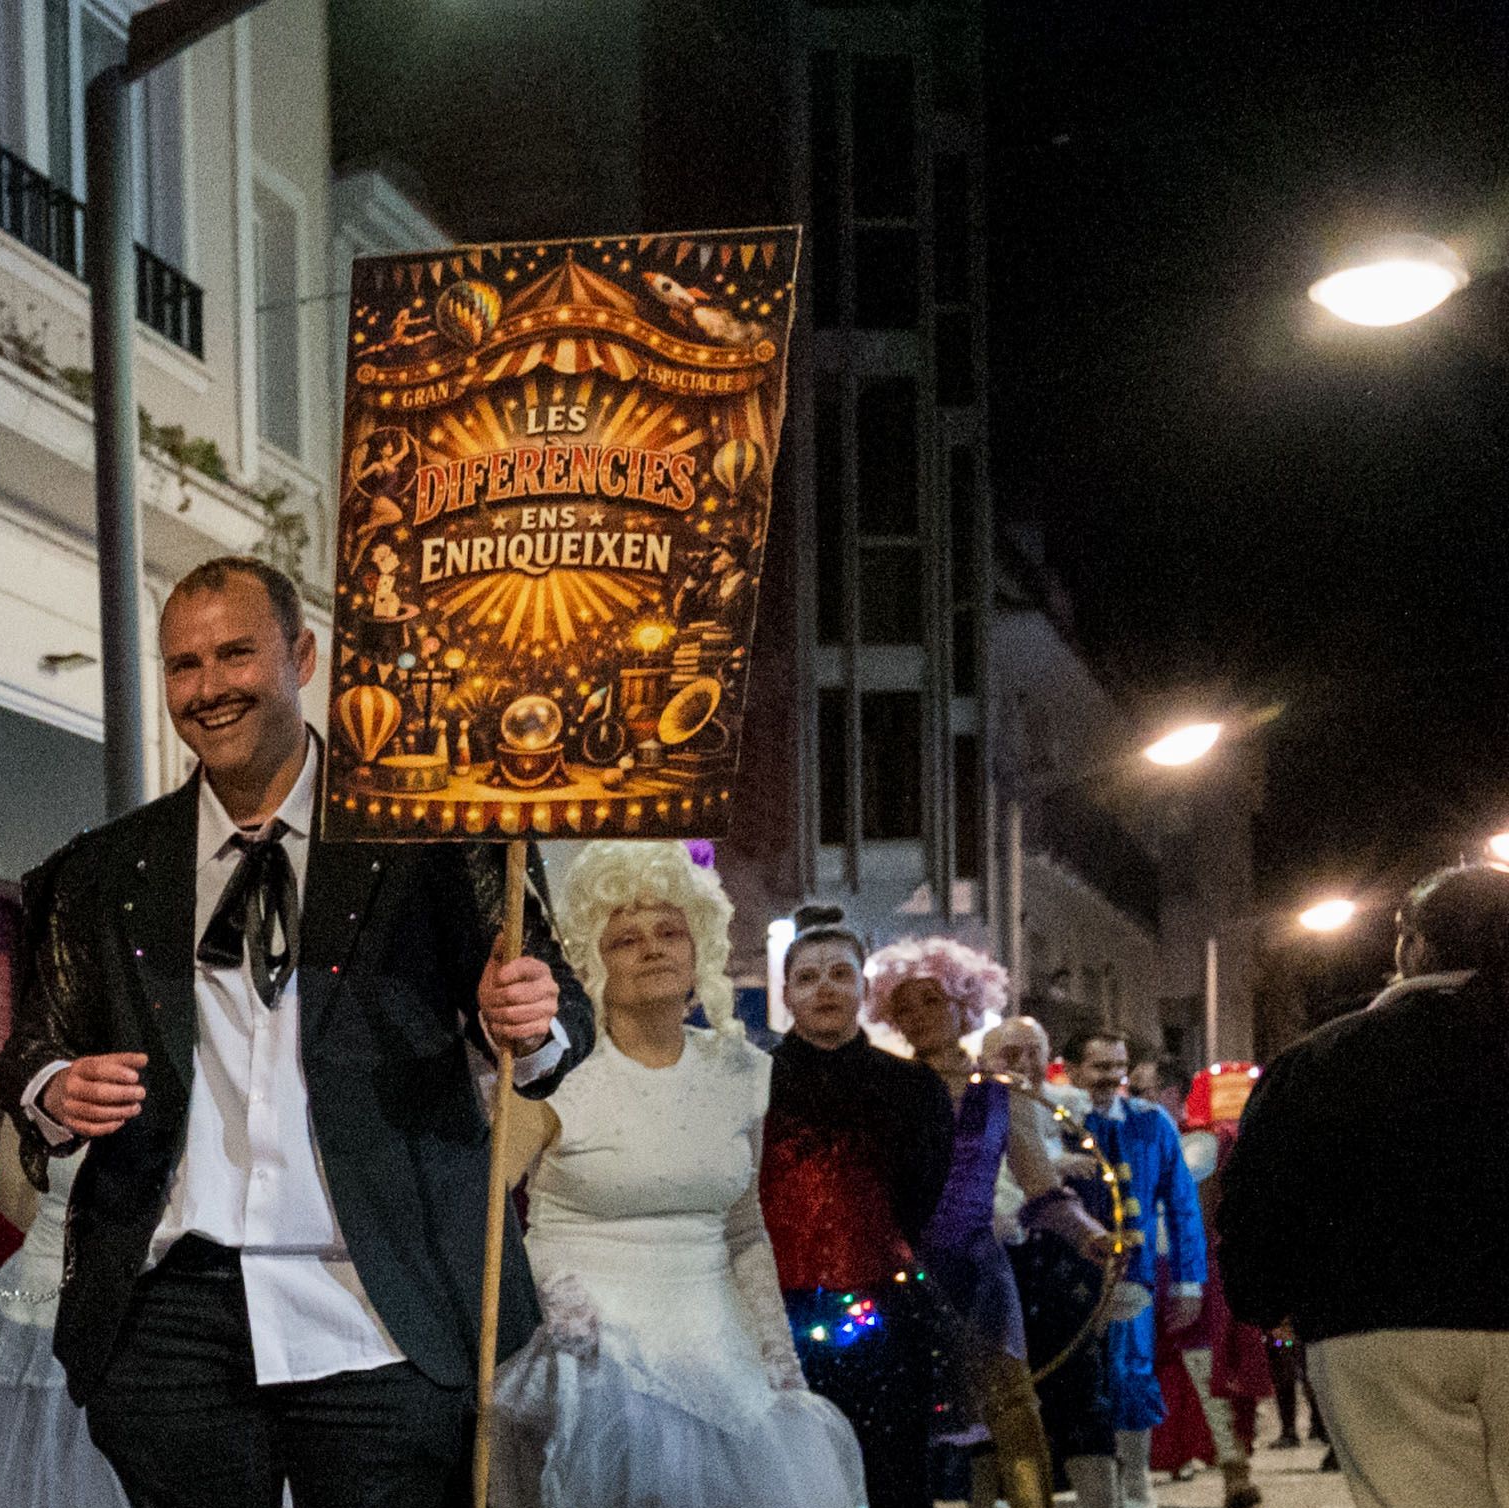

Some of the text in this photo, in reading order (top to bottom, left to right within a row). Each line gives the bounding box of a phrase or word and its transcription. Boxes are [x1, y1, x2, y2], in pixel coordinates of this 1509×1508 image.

[402, 383, 450, 408] GRAN
[526, 405, 588, 435] LES
[521, 506, 576, 530] ENS
[419, 532, 672, 584] ENRIQUEIXEN
